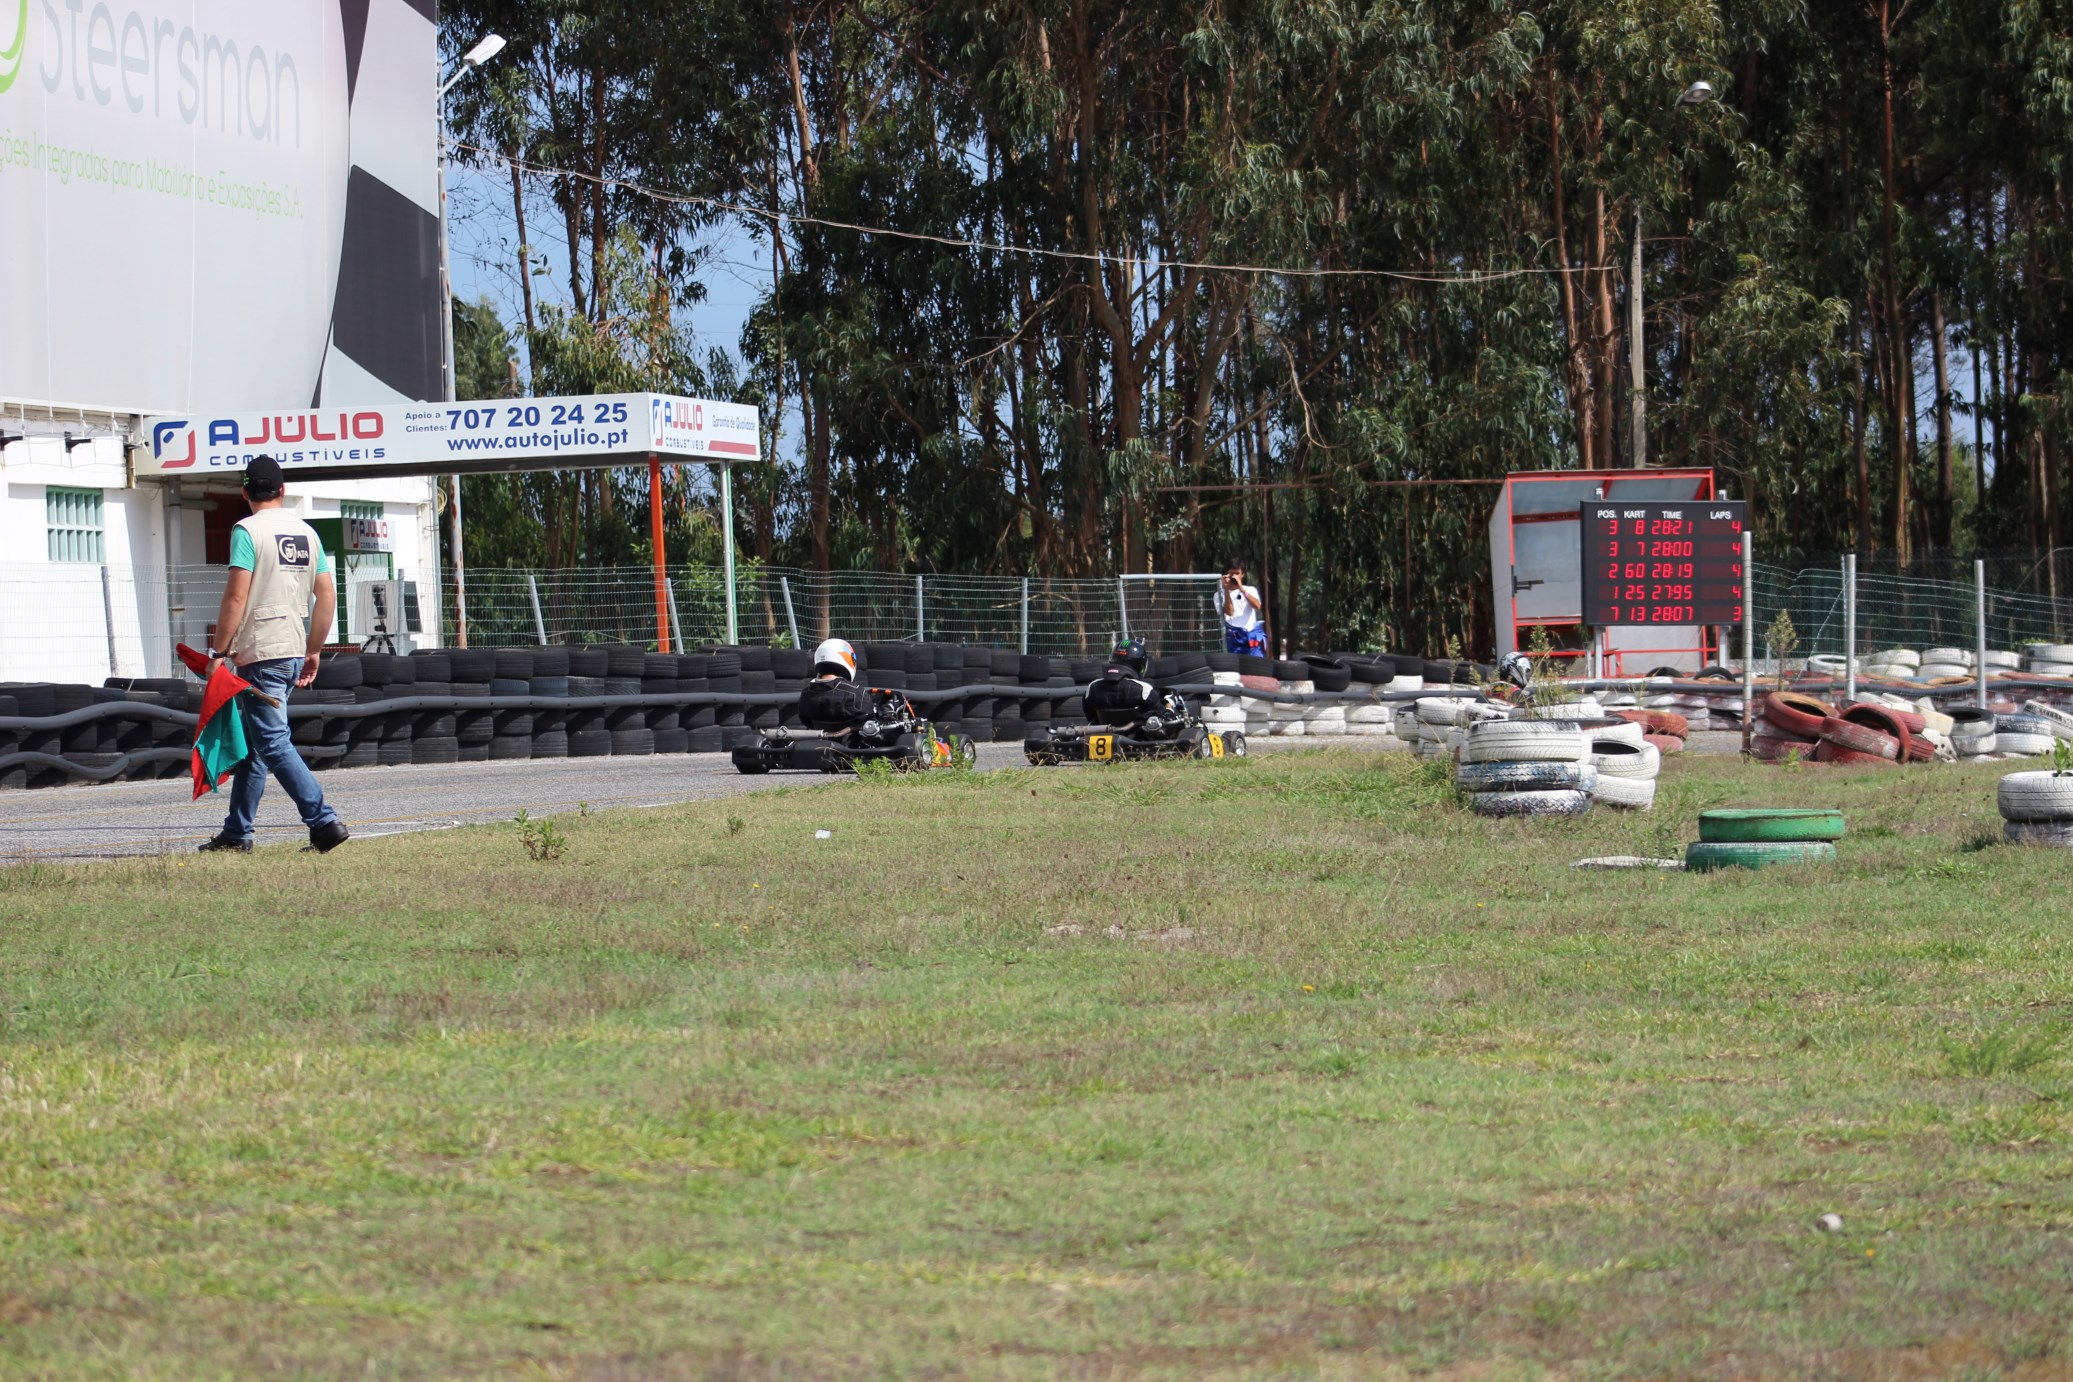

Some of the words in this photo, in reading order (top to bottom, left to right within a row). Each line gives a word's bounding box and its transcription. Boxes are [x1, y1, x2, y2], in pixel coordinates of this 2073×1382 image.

[39, 0, 300, 148] Steersman
[33, 131, 109, 185] Integradas
[112, 159, 143, 194] para
[208, 178, 215, 203] e
[405, 411, 432, 421] Apoio
[446, 408, 497, 430] 707
[507, 406, 541, 428] 20
[550, 404, 585, 425] 24
[594, 403, 628, 424] 25
[405, 425, 448, 433] Clientes:
[447, 428, 628, 451] www.autojulio.pt
[209, 447, 386, 466] COMUSTÍVEIS
[1597, 510, 1617, 519] POS.
[1623, 510, 1646, 519] KART
[1661, 510, 1682, 520] TIME
[1710, 511, 1732, 520] LAPS
[1609, 520, 1619, 535] 3
[1635, 520, 1645, 535] 8
[1731, 520, 1742, 535] 4
[1609, 541, 1619, 557] 3
[1636, 541, 1646, 557] 7
[1731, 541, 1742, 557] 4
[1608, 563, 1619, 578] 2
[1624, 563, 1646, 578] 60
[1732, 563, 1742, 578] 4
[1624, 585, 1646, 600] 25
[1732, 585, 1742, 600] 4
[1610, 606, 1620, 622] 7
[1630, 606, 1646, 622] 13
[1732, 606, 1742, 622] 3
[1095, 737, 1106, 756] 8
